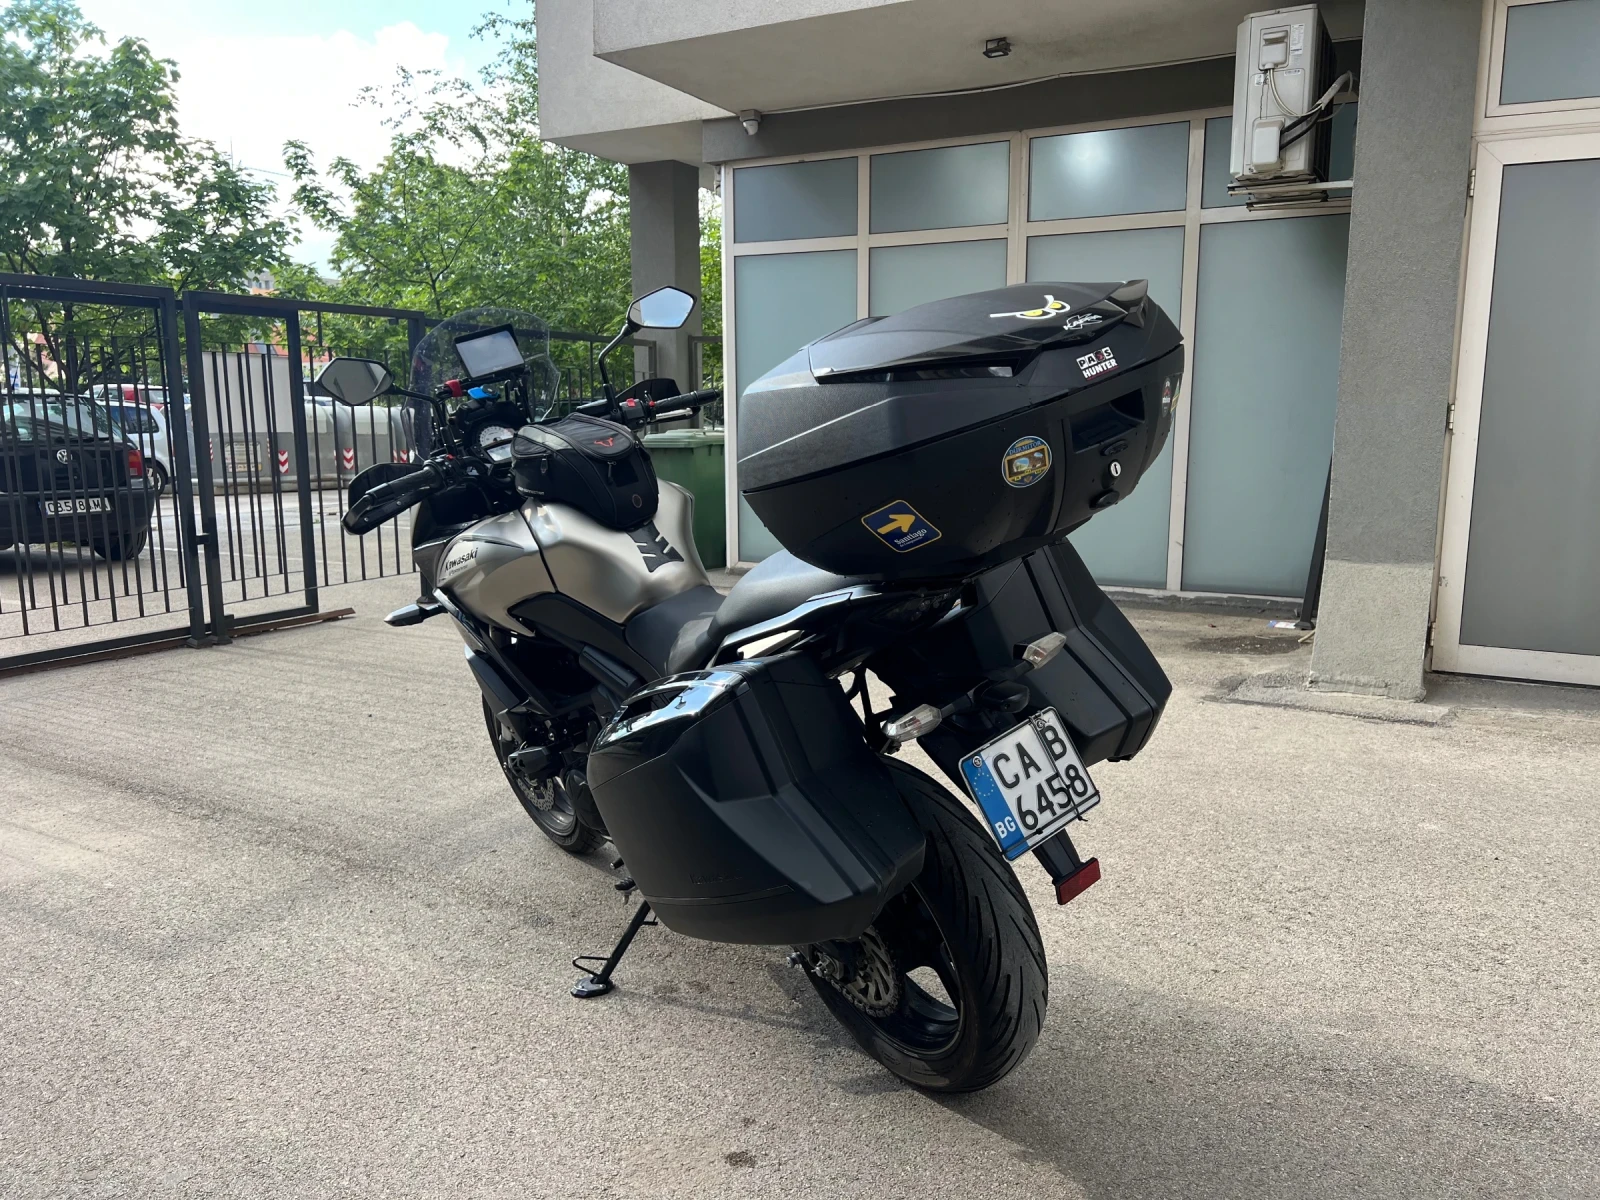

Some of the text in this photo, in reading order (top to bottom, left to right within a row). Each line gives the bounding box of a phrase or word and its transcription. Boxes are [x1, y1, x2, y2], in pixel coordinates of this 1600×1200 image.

[1082, 358, 1118, 379] HUNTER
[894, 528, 927, 545] Santiago
[445, 547, 478, 572] Kawasaki
[993, 725, 1067, 789] CA B
[1016, 763, 1088, 831] 6458
[995, 816, 1017, 838] BG
